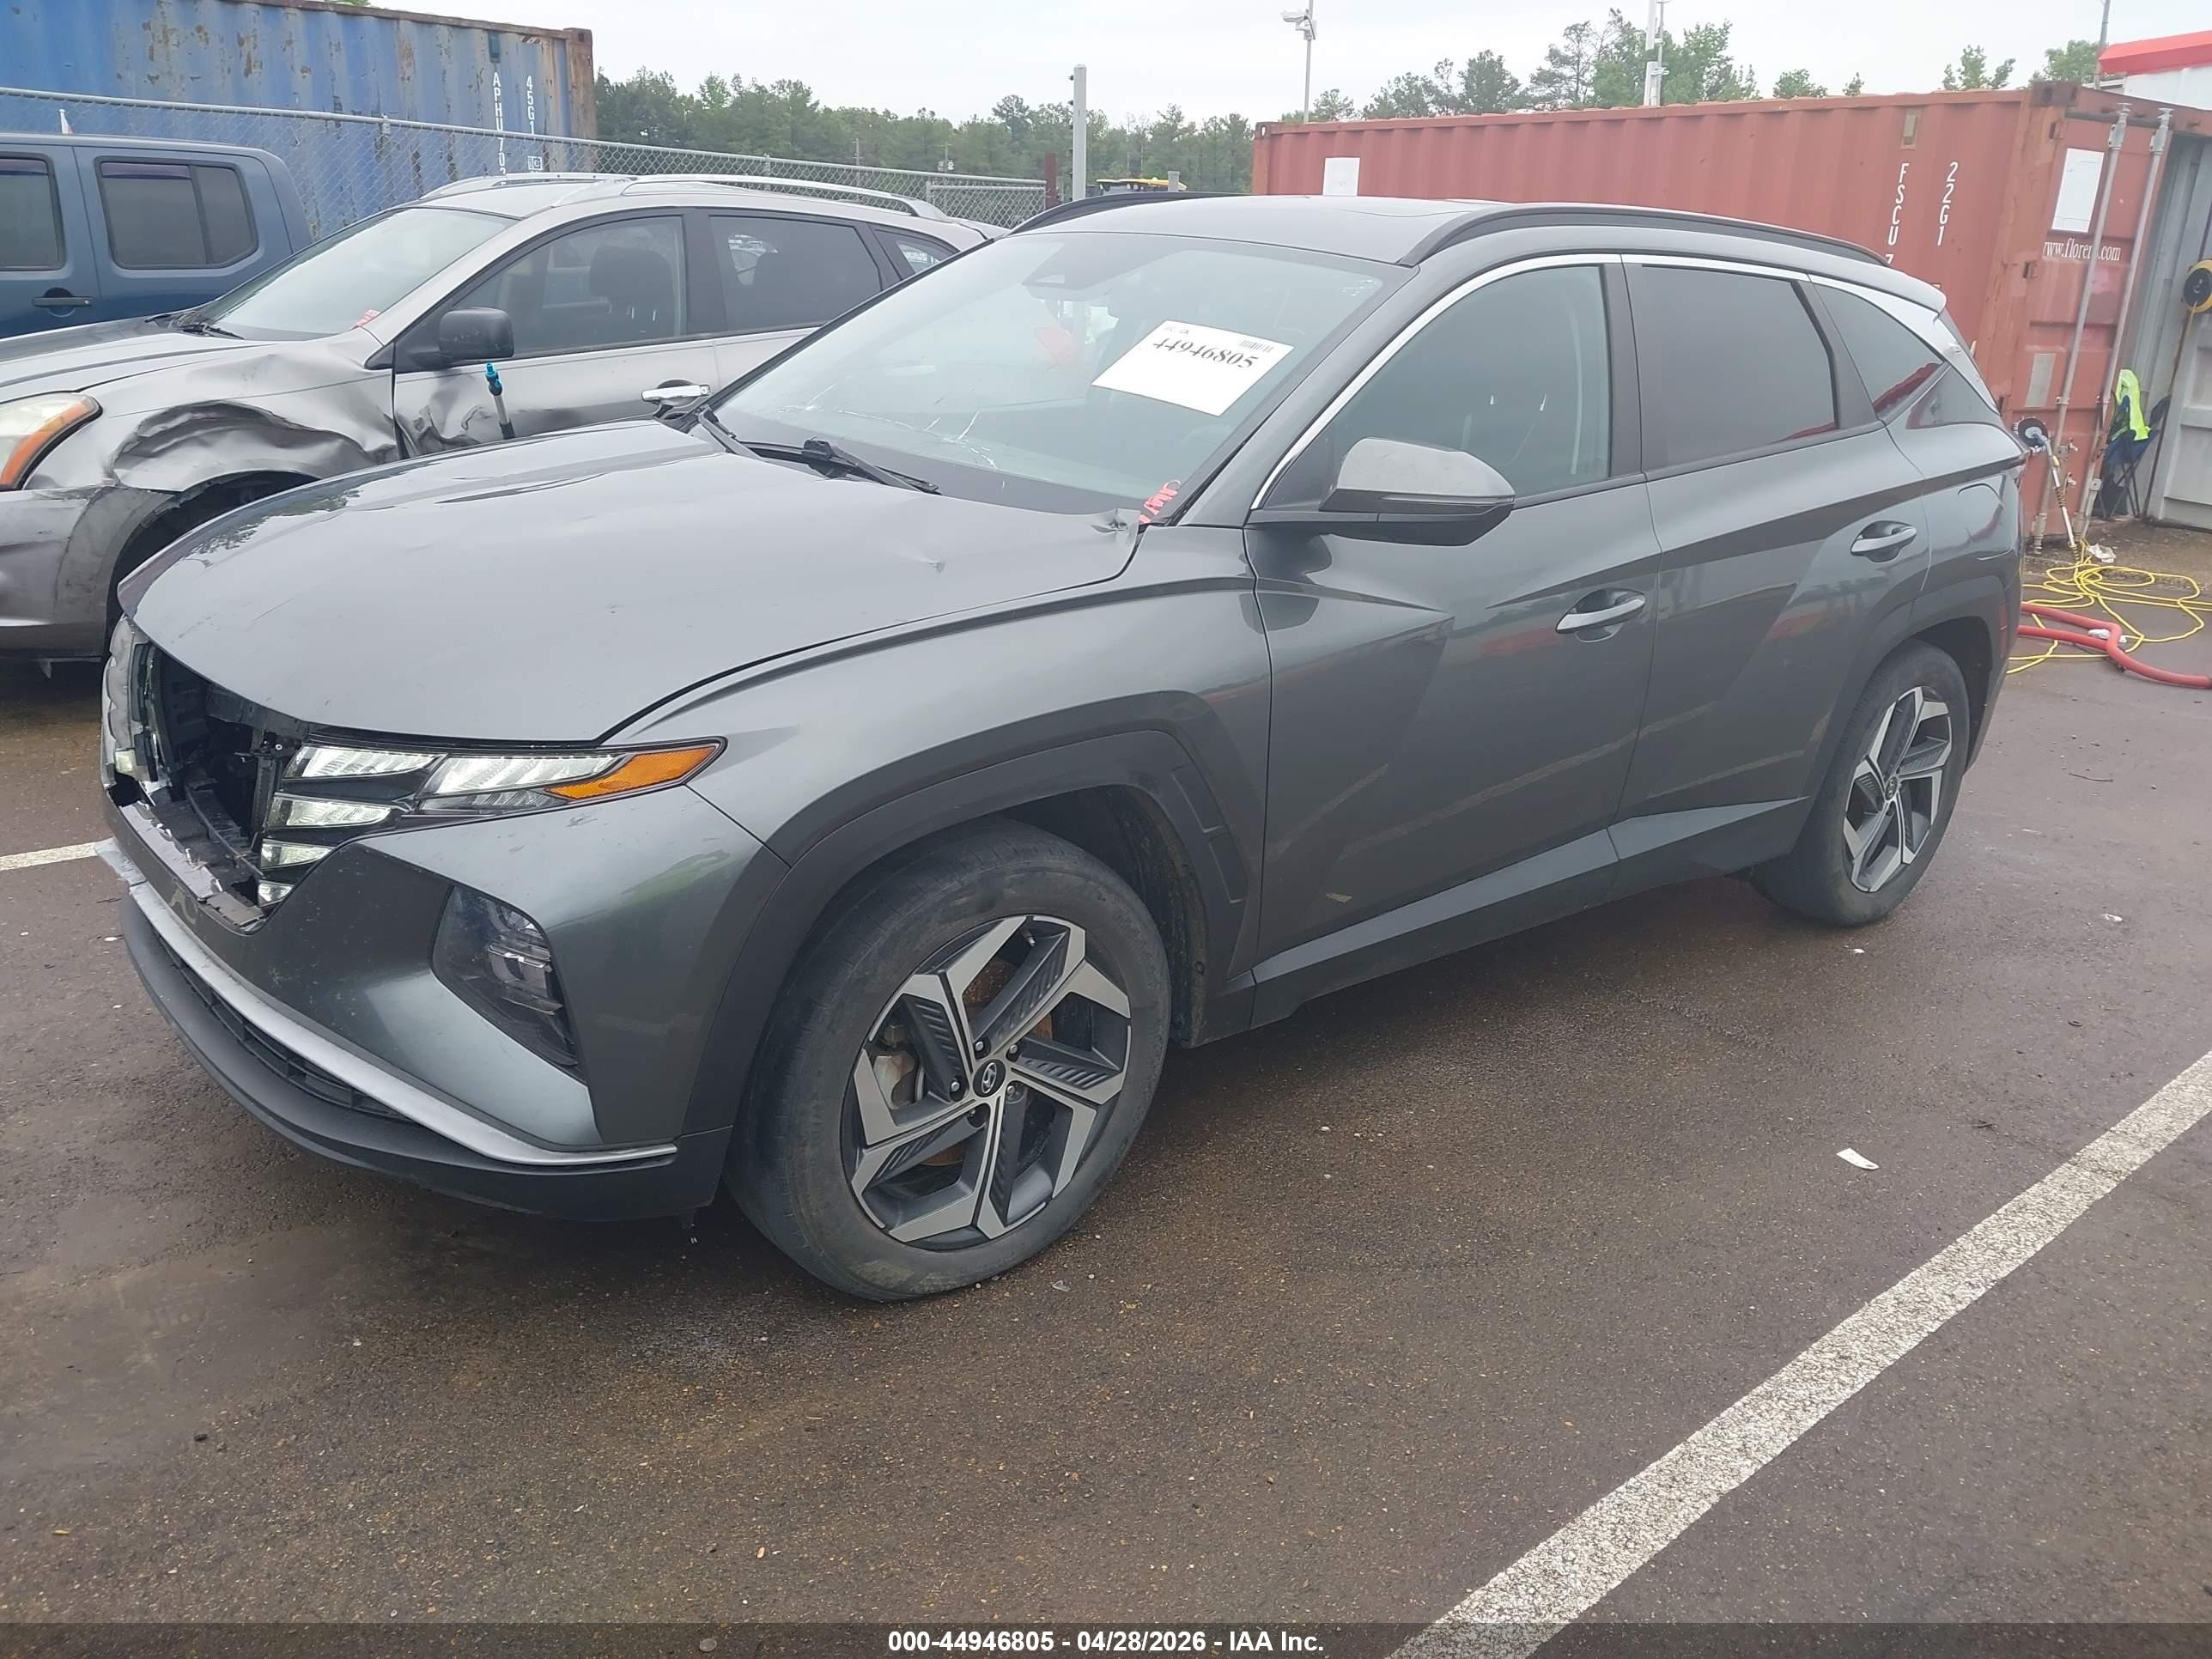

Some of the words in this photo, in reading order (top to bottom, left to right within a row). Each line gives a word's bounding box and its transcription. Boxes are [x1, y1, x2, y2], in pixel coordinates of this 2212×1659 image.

[492, 71, 503, 131] APHU
[526, 75, 535, 135] 45G1
[1887, 162, 1910, 246] FSCU
[1936, 161, 1959, 246] 22G1
[1153, 337, 1260, 368] 44946805
